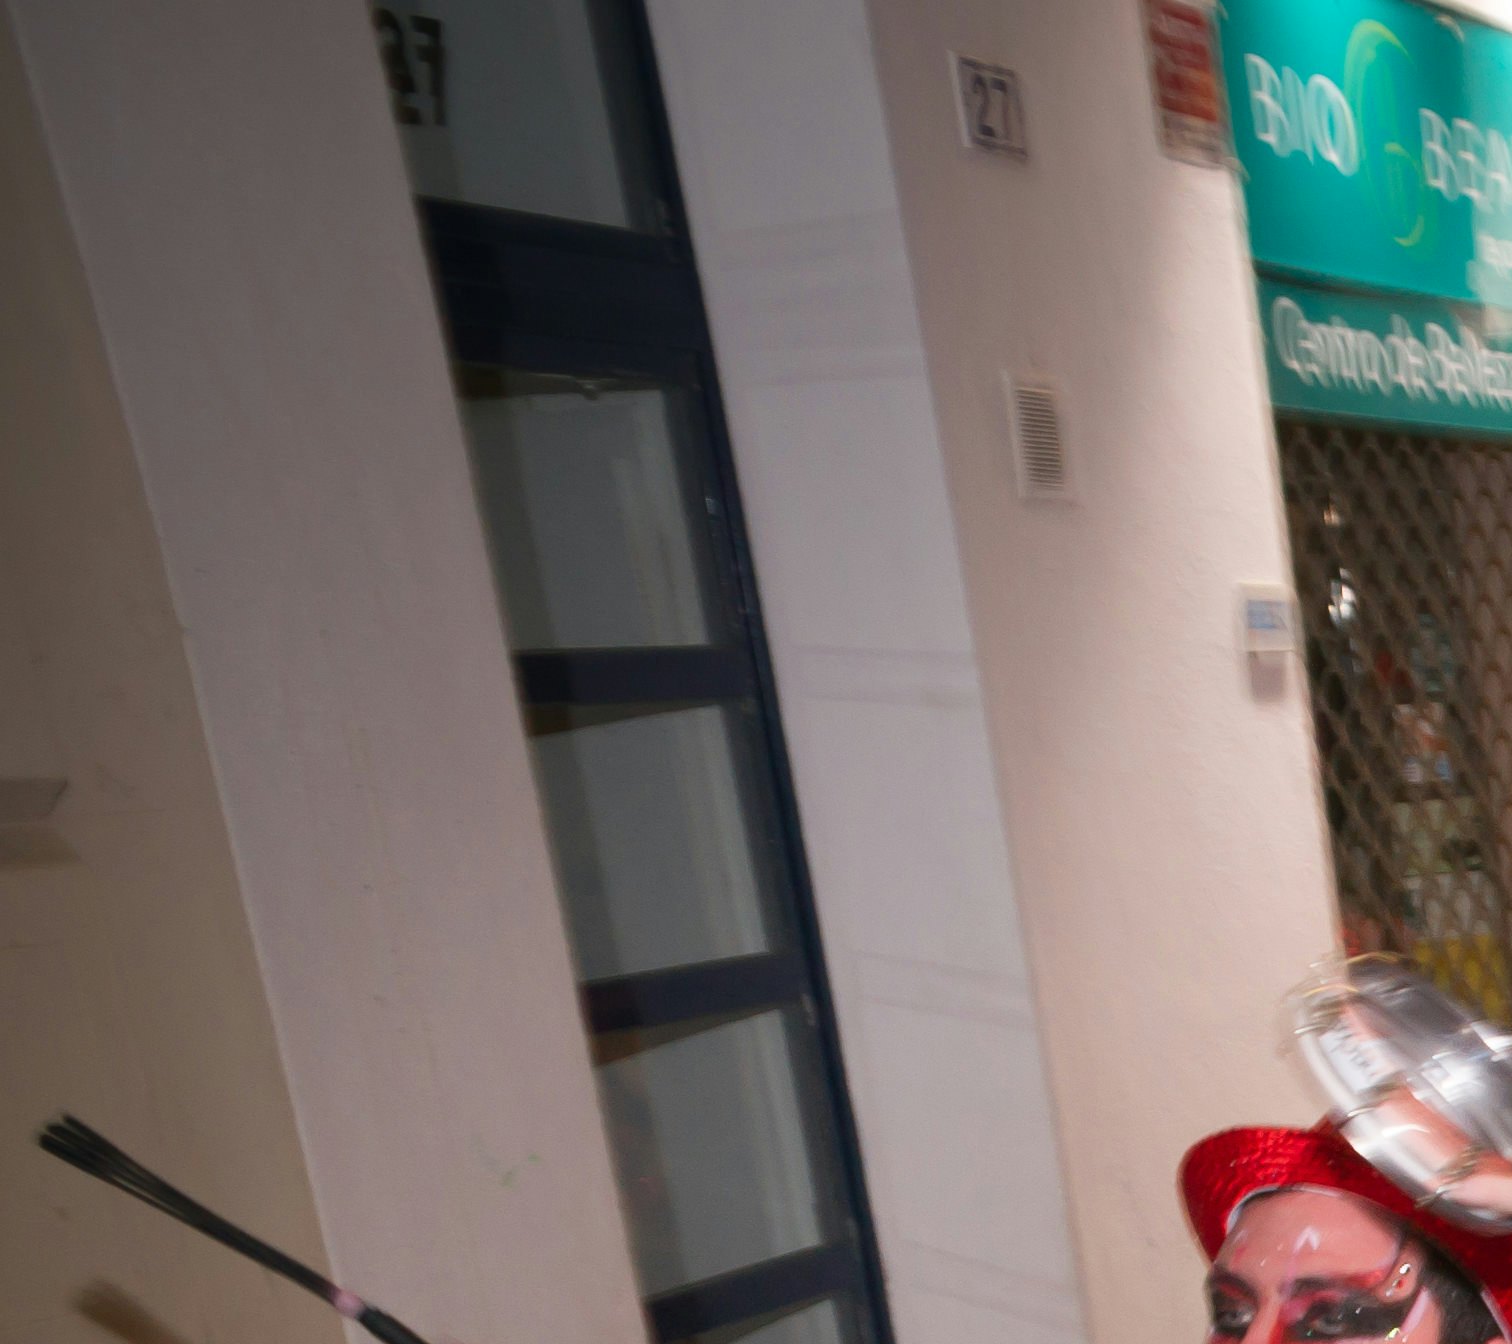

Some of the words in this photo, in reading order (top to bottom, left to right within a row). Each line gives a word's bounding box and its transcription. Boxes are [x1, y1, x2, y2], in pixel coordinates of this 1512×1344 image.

[369, 7, 447, 126] 27
[971, 73, 1012, 139] 27
[1244, 53, 1358, 176] BIO
